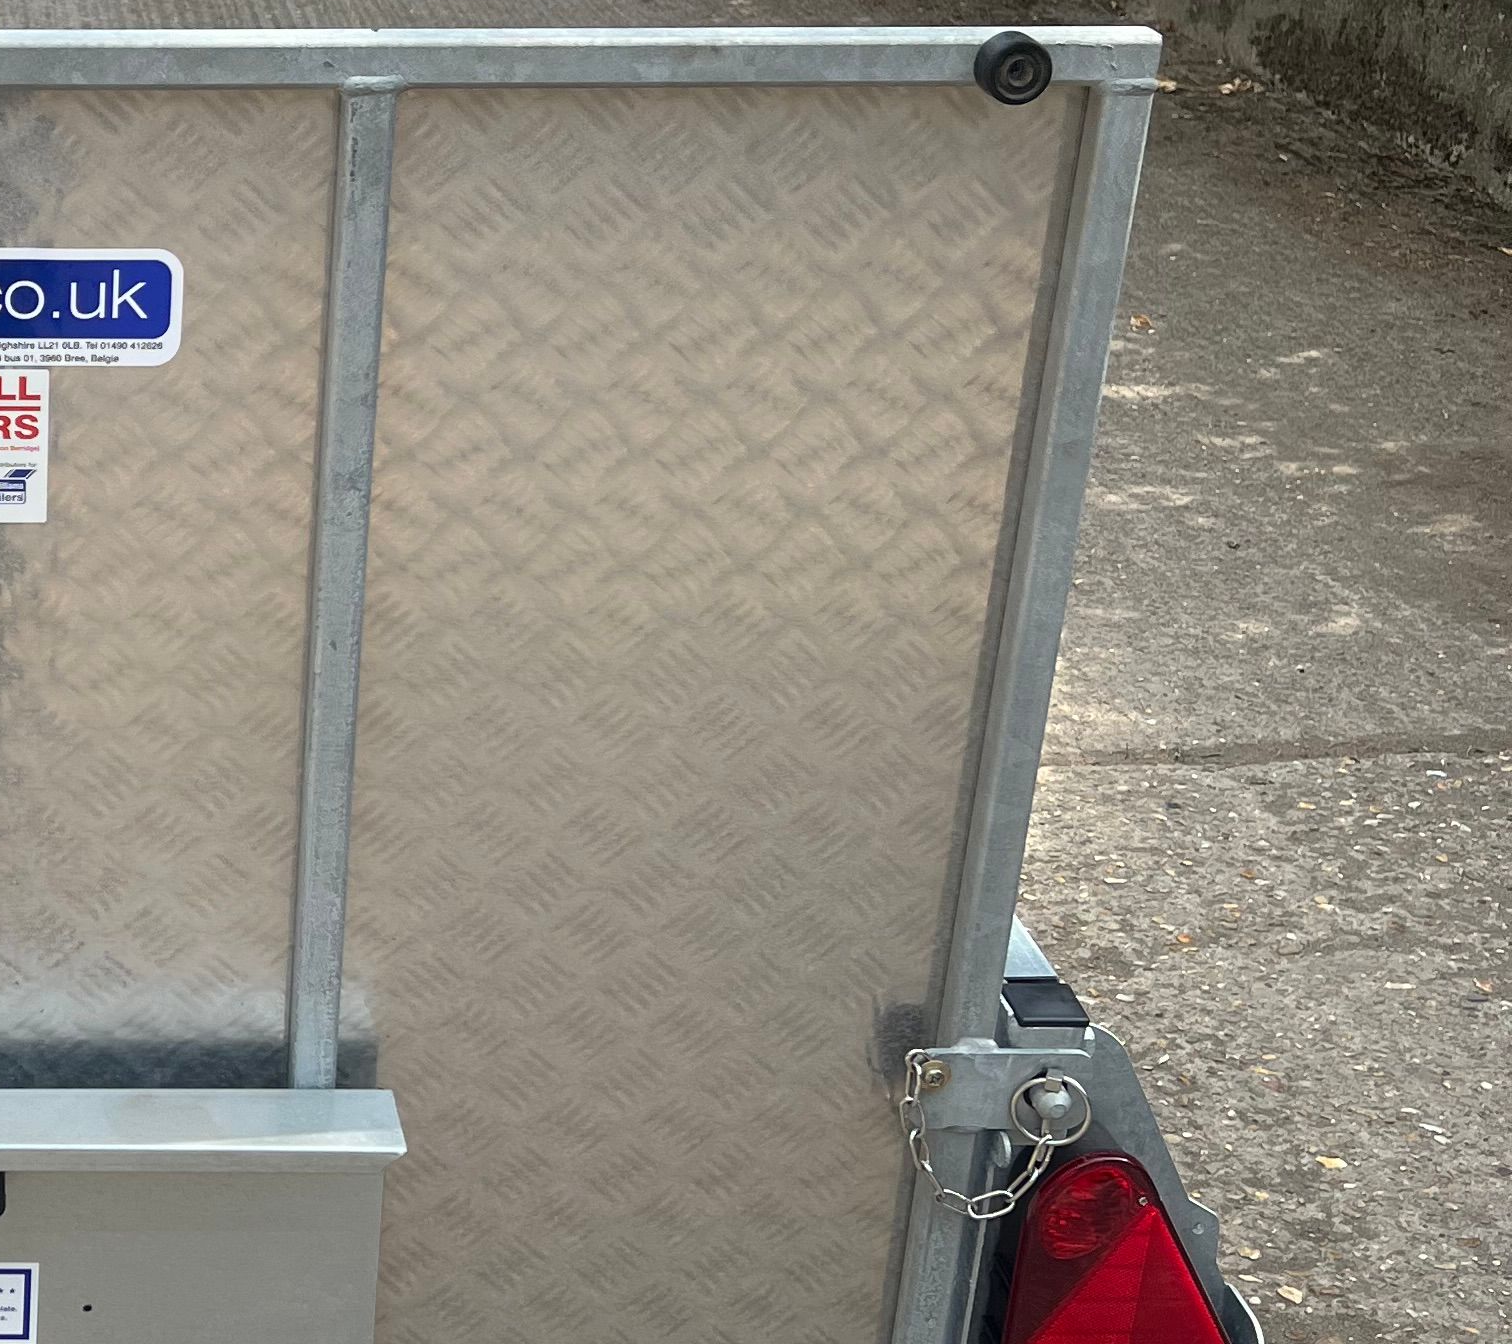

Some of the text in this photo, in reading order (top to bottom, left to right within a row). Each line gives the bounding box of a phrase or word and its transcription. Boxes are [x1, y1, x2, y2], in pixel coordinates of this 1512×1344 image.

[38, 342, 59, 350] LL21
[86, 342, 98, 350] Tel
[100, 342, 128, 350] 01490
[4, 354, 21, 362] bus
